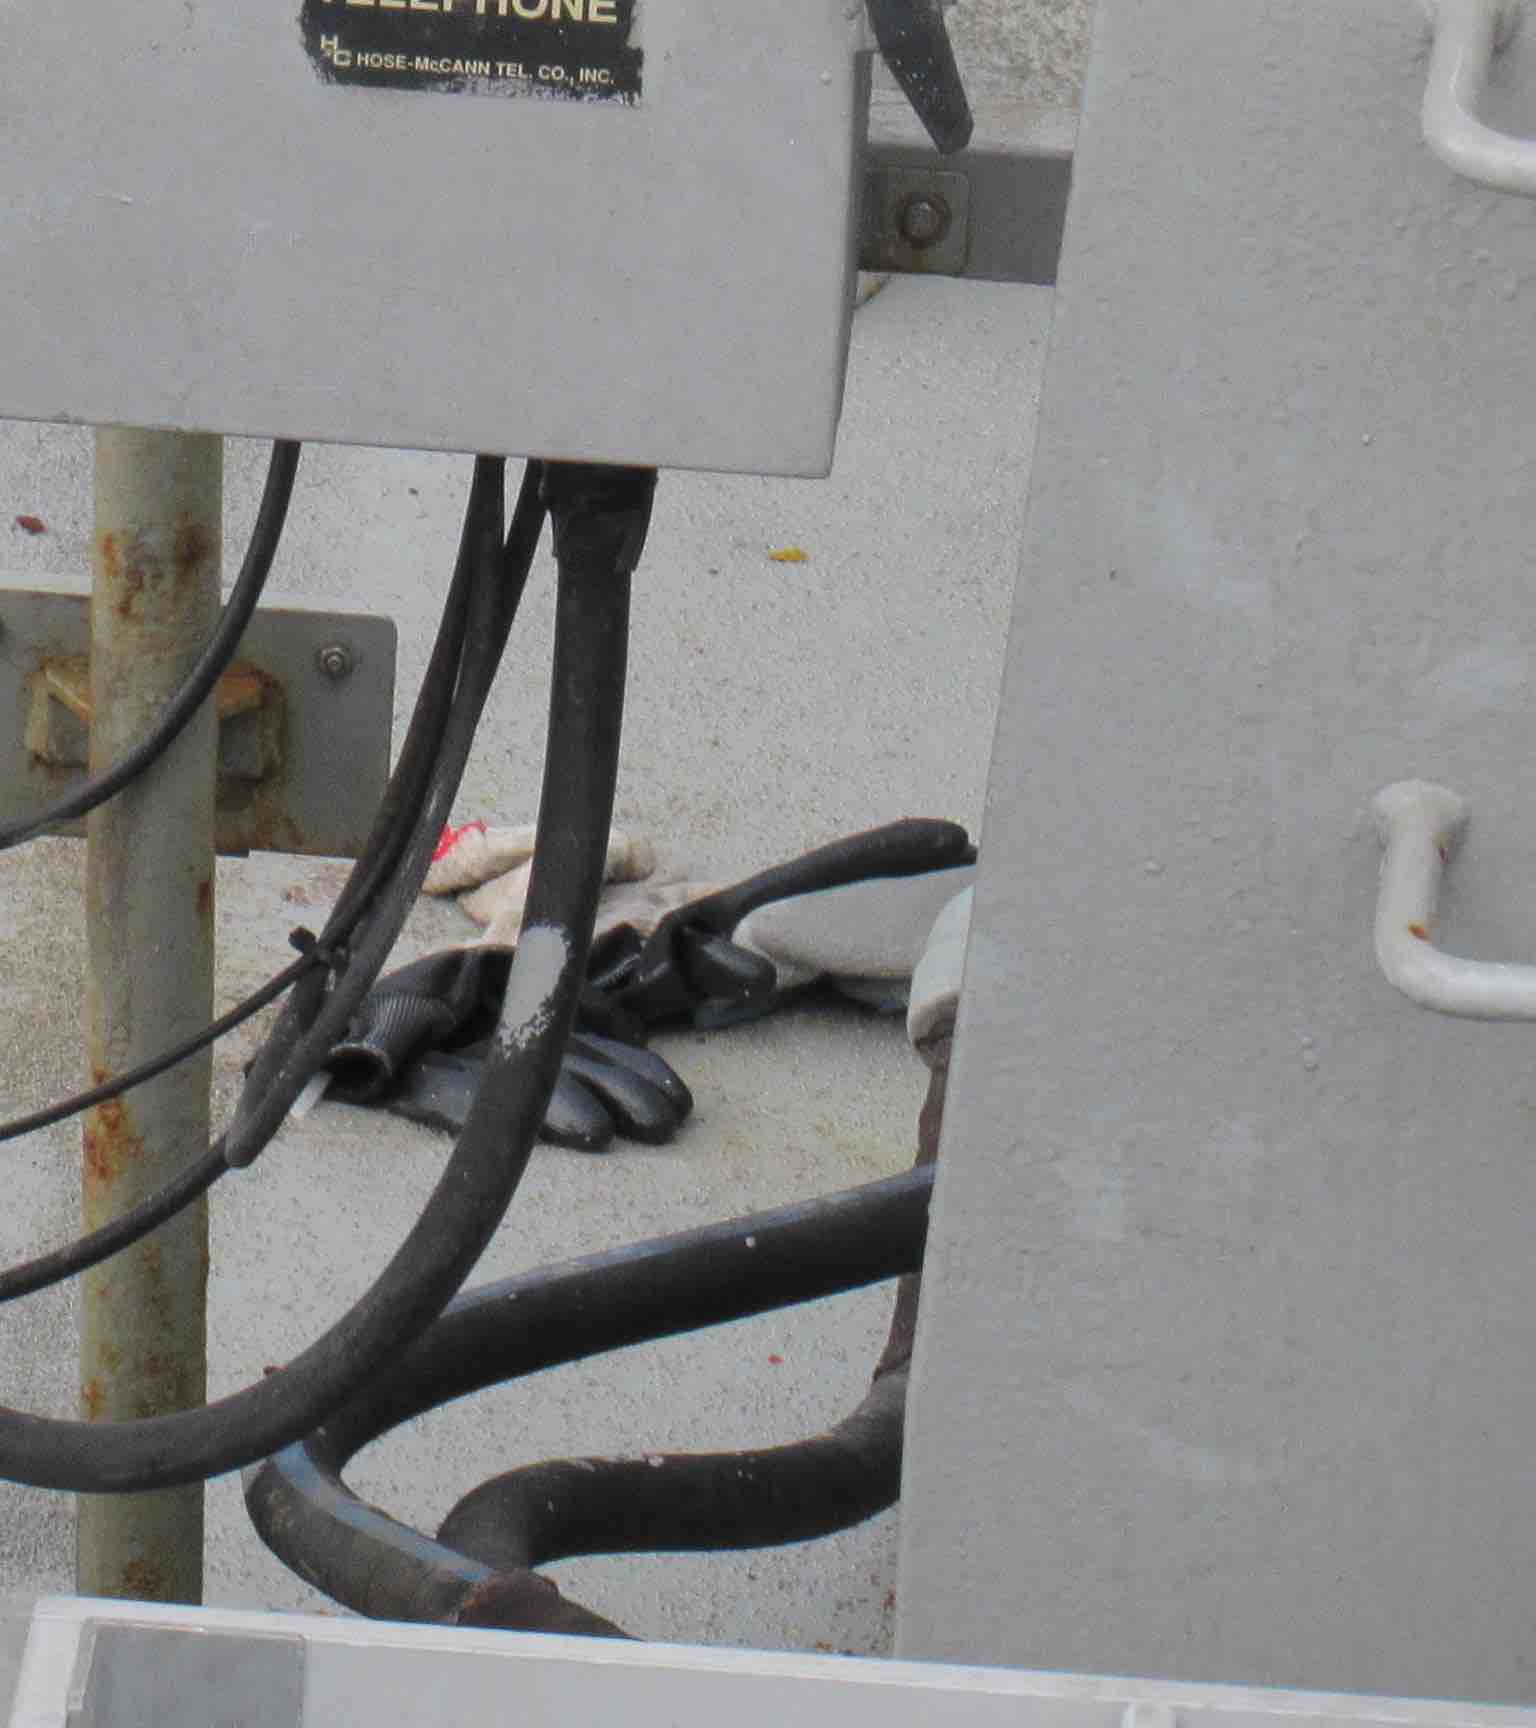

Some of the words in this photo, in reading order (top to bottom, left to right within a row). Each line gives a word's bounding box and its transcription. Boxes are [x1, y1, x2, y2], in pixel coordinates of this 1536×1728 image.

[356, 52, 491, 77] HOSE-McCANN
[497, 60, 533, 79] TEL.
[538, 66, 575, 85] CO.,
[579, 67, 616, 85] INC.
